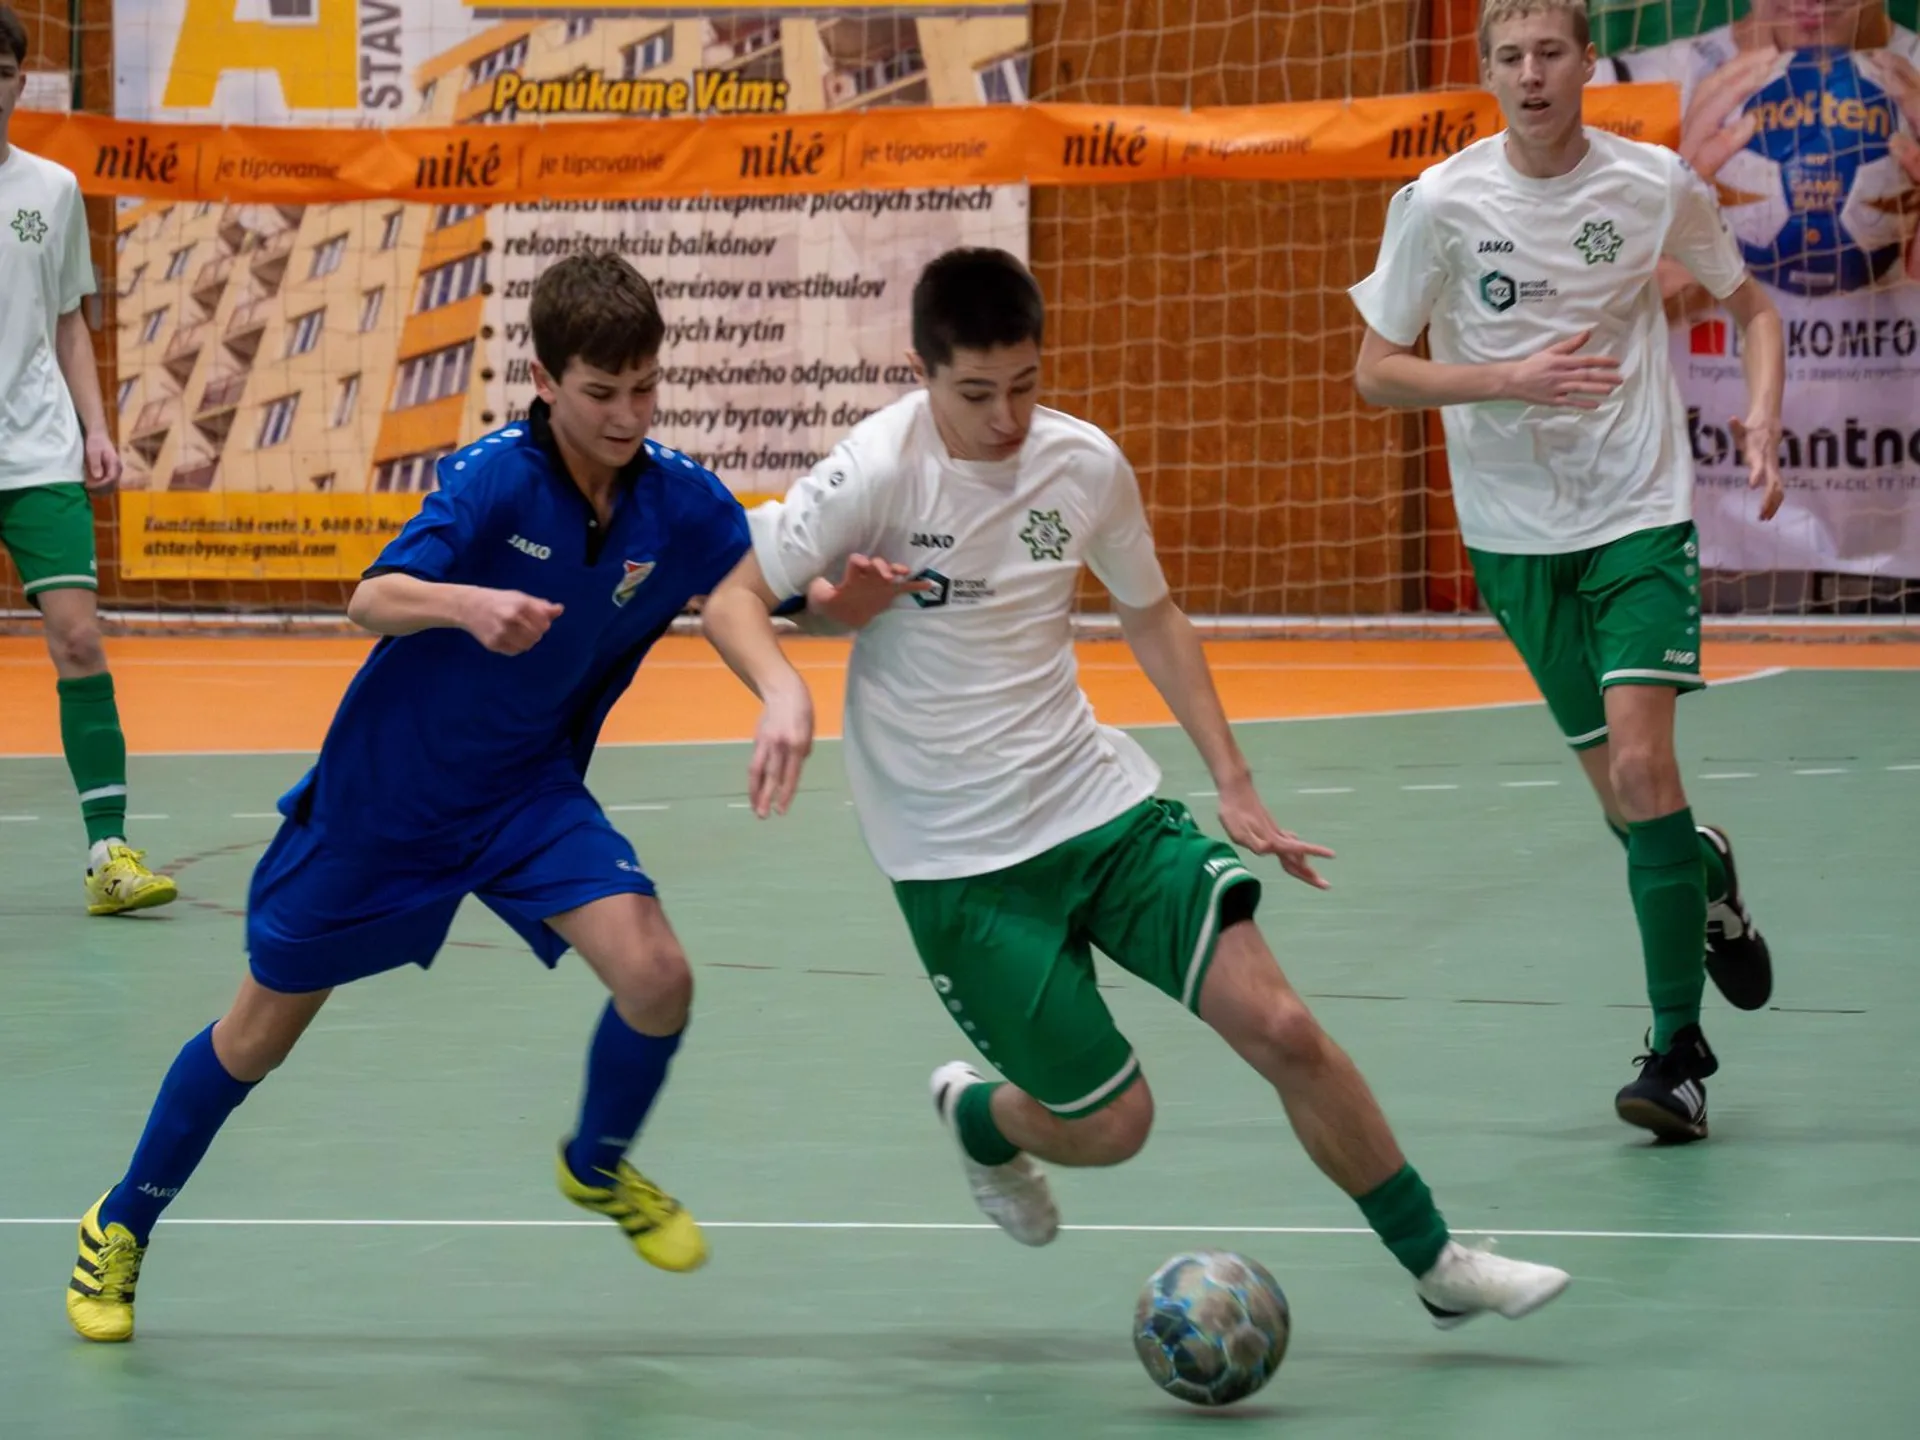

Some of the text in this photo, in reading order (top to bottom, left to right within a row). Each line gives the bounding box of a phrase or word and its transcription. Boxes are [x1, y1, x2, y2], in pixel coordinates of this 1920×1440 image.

[492, 66, 789, 114] Ponúkame Vám:
[95, 136, 339, 184] niké je tipovanie
[740, 128, 825, 179] niké
[885, 138, 988, 164] tipovanie
[1063, 122, 1147, 169] niké
[416, 138, 665, 188] niké je tipovanie
[503, 229, 776, 256] rekonštrukciu balkónov
[1477, 240, 1515, 254] JAKO
[748, 281, 761, 298] a
[768, 272, 886, 299] vestibulov
[715, 315, 785, 348] krytín
[791, 358, 880, 390] odpadu
[651, 402, 719, 433] bnovy
[724, 401, 827, 432] bytových
[507, 533, 552, 560] JAKO
[909, 532, 955, 548] JAKO
